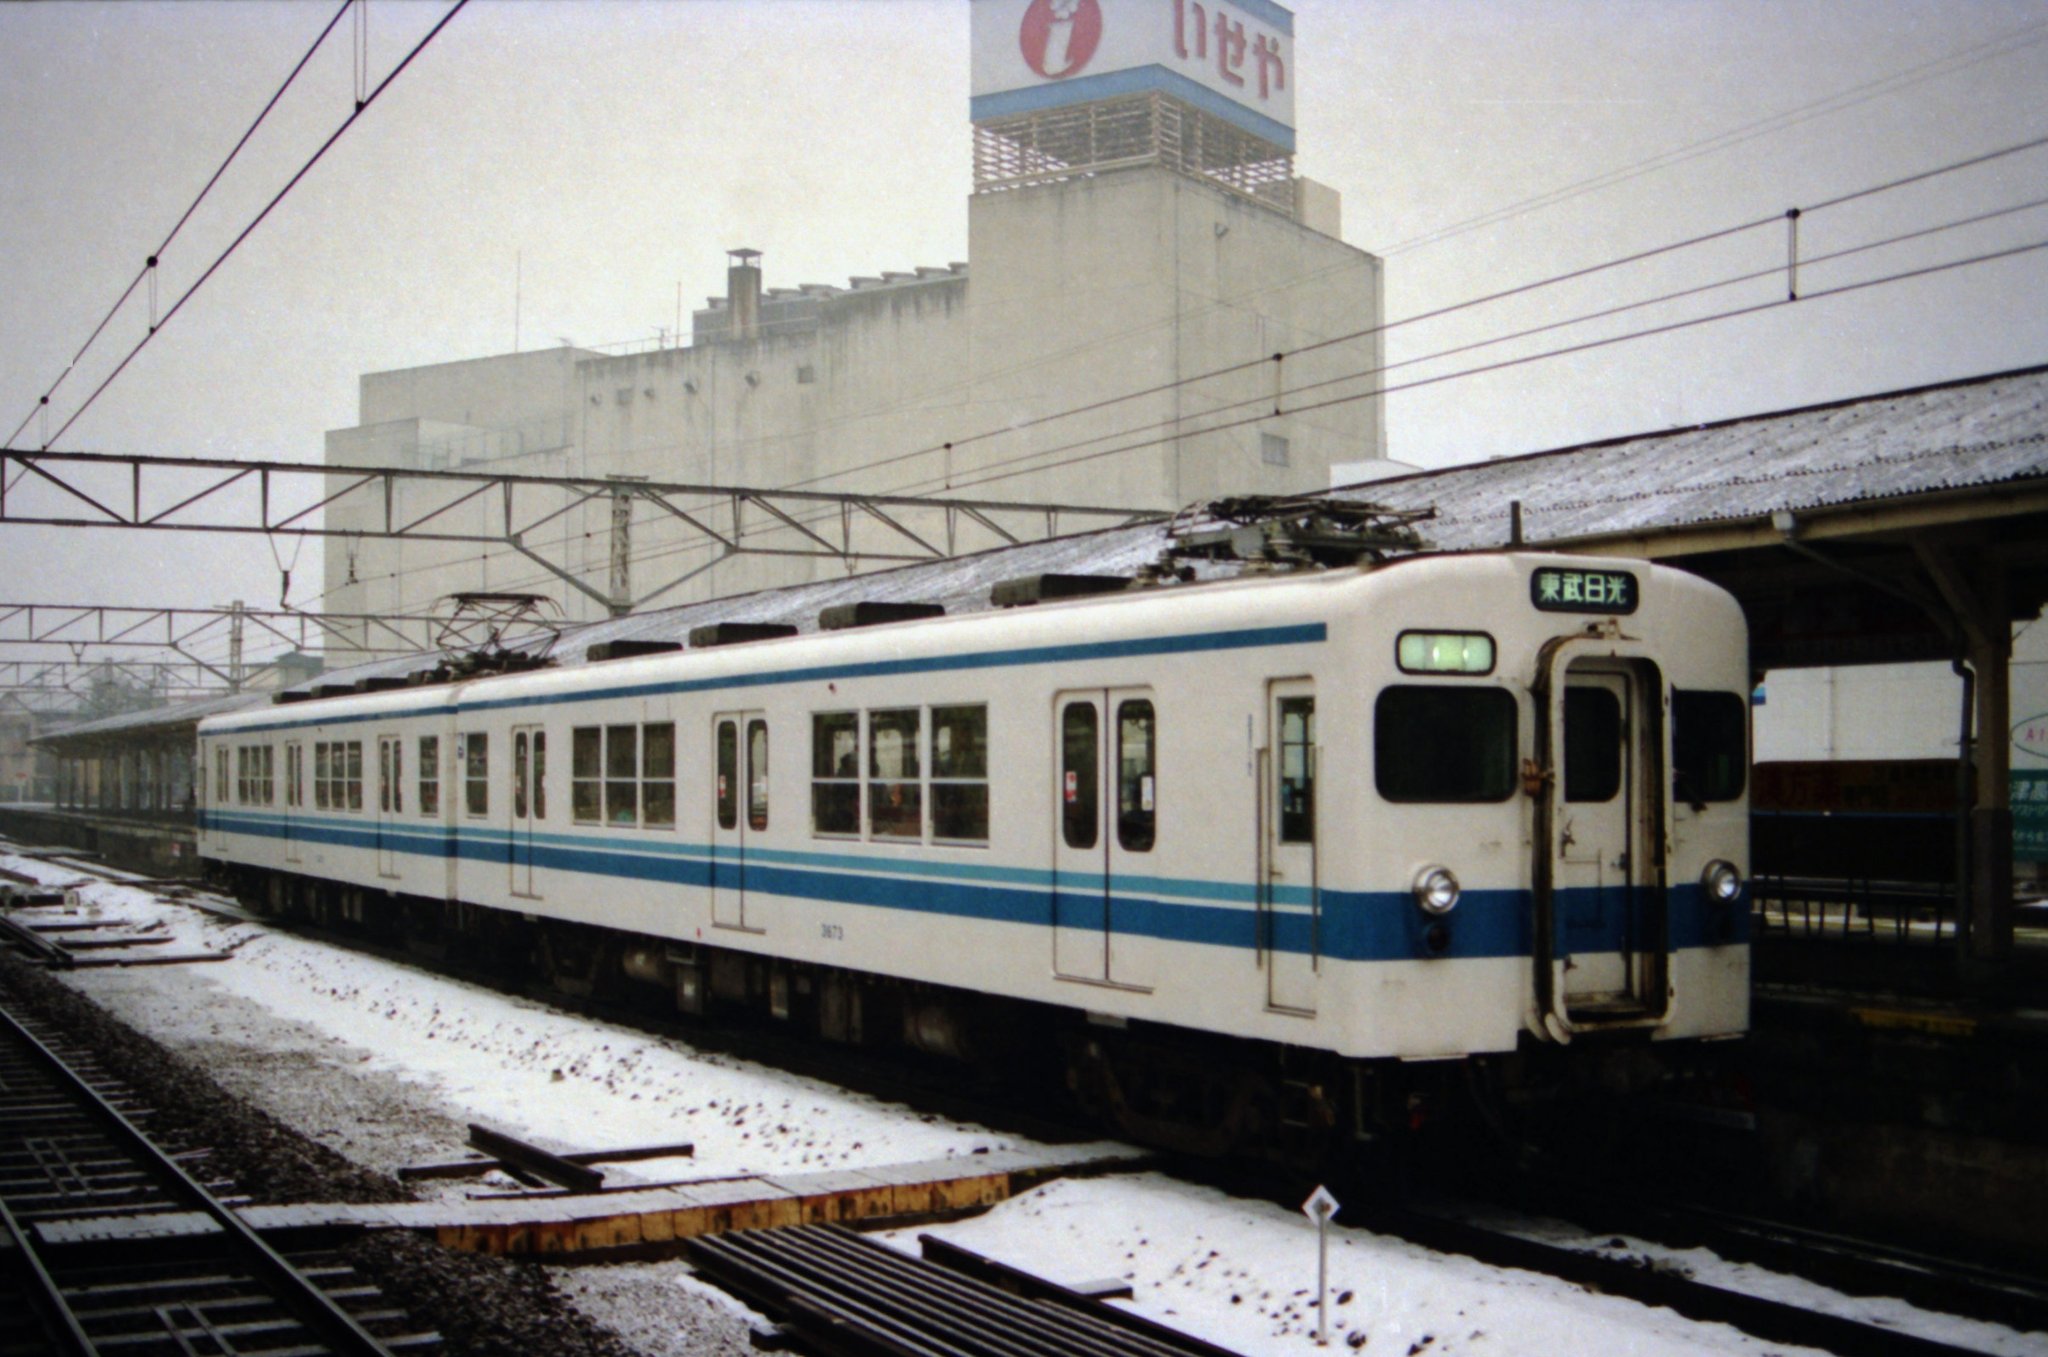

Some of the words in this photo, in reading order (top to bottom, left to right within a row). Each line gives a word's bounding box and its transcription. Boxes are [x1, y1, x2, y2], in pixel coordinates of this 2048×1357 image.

[1173, 0, 1286, 100] いせや
[1539, 572, 1627, 604] 東武日光
